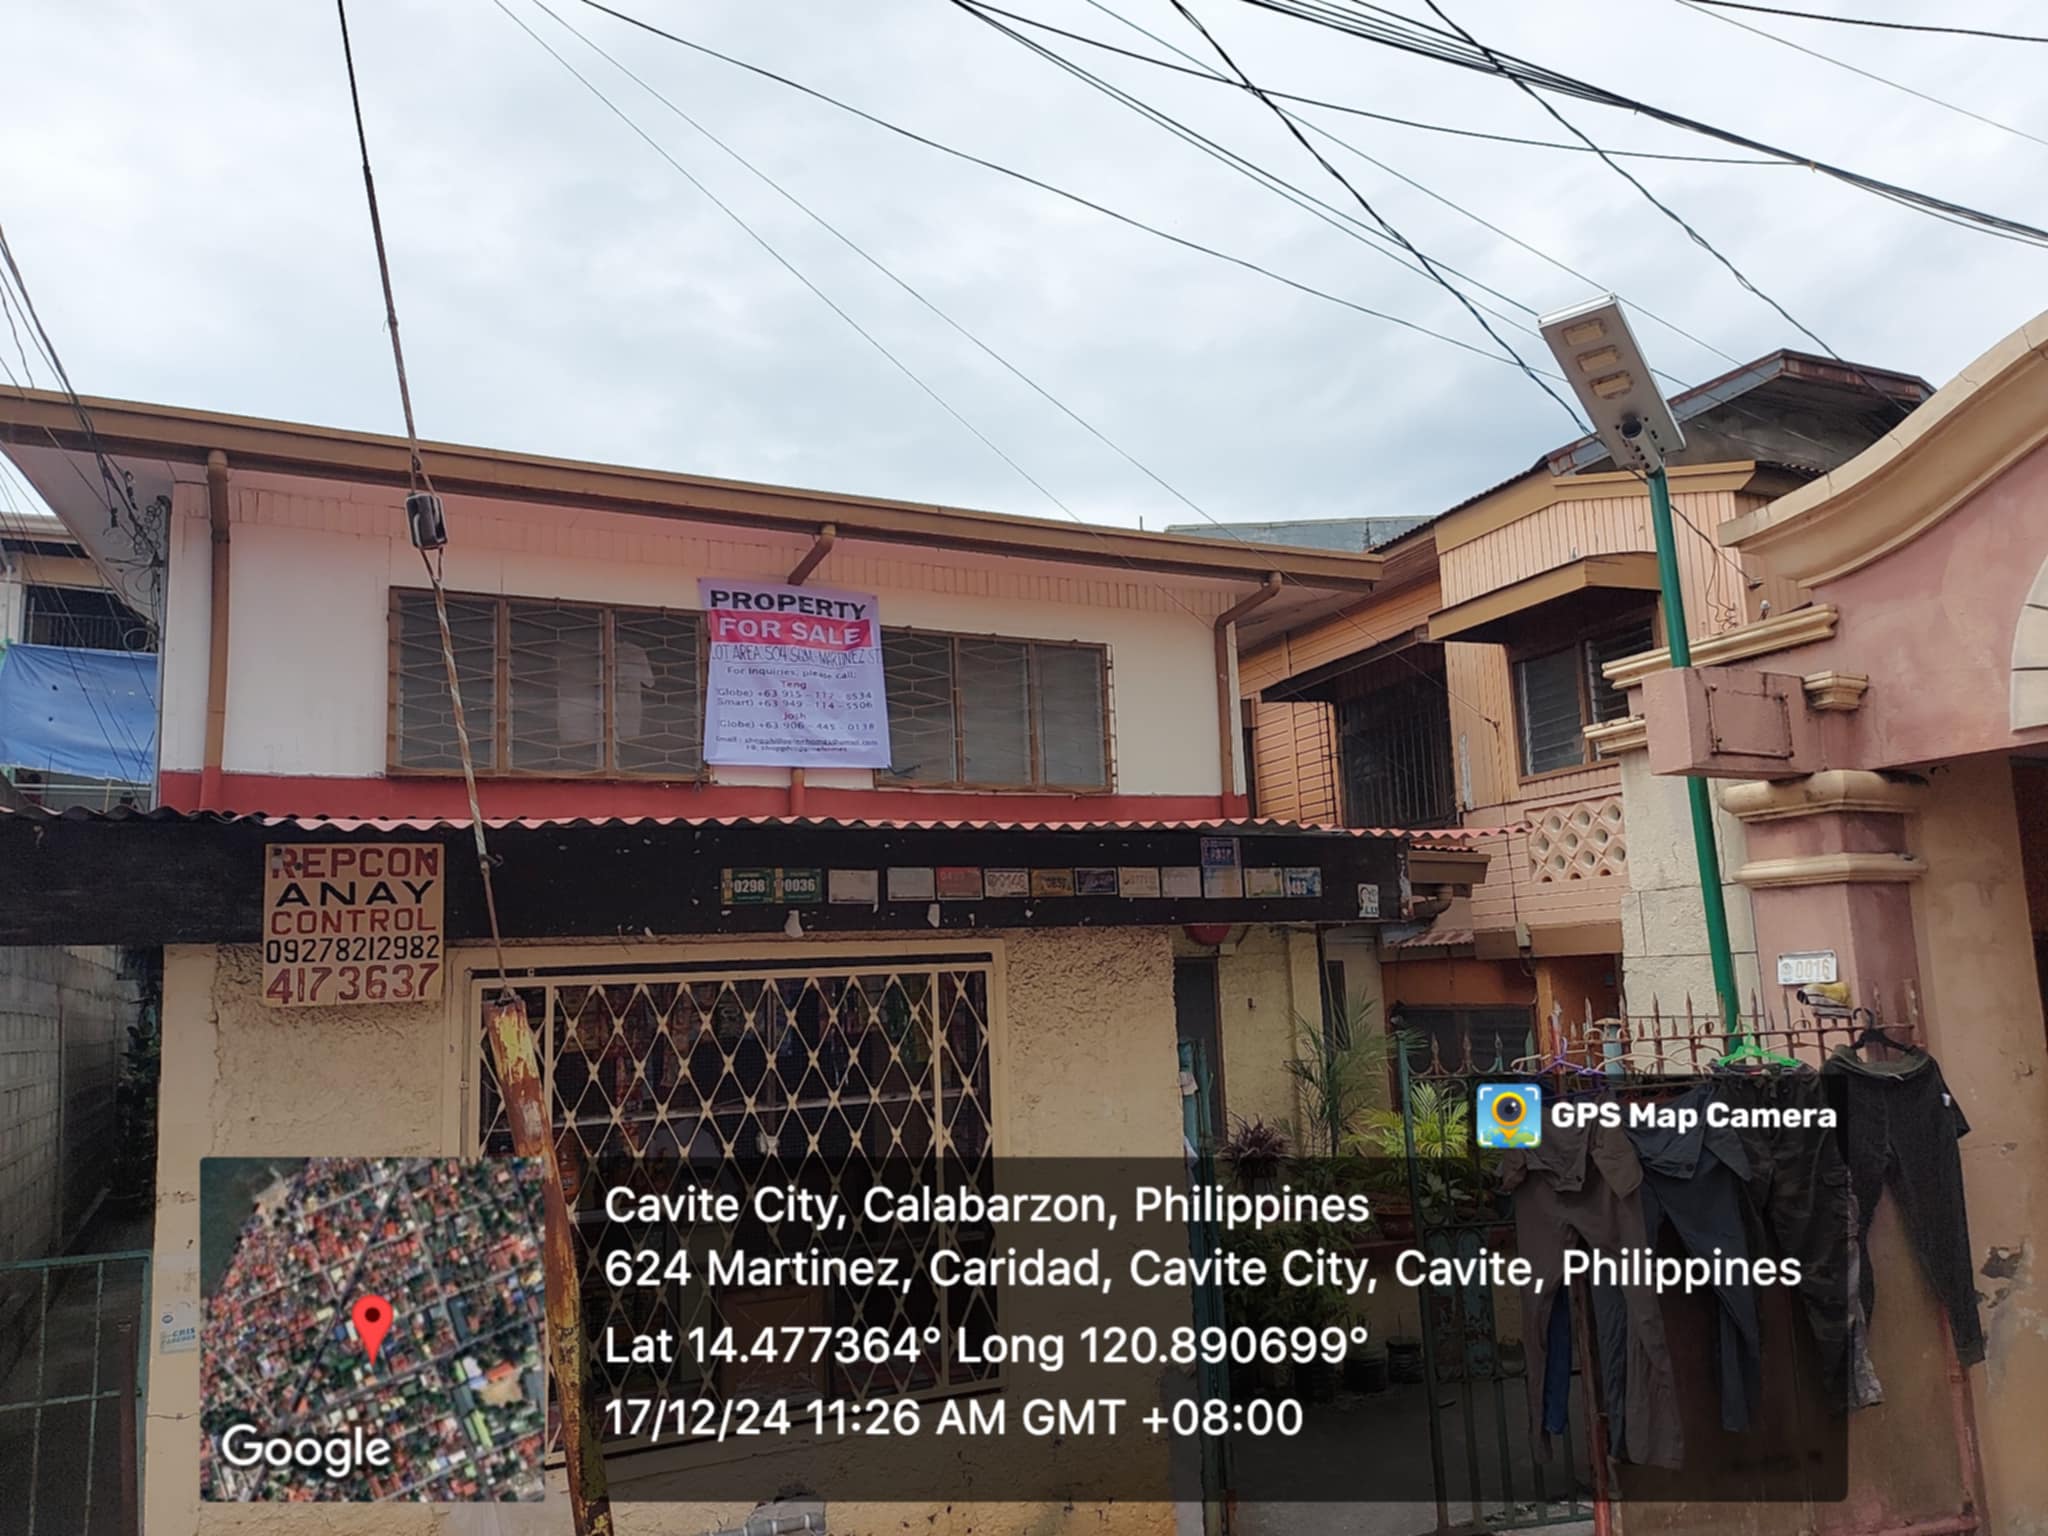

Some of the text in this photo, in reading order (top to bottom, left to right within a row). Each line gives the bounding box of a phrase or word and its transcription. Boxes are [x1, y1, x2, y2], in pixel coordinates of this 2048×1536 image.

[710, 590, 867, 620] PROPERTY
[719, 618, 862, 645] FOR SALE
[272, 847, 438, 879] REPCON
[276, 880, 434, 907] ANAY
[734, 879, 765, 893] 0298
[784, 878, 815, 892] 0036
[271, 908, 437, 935] CONTROL
[266, 935, 440, 964] 09278212982
